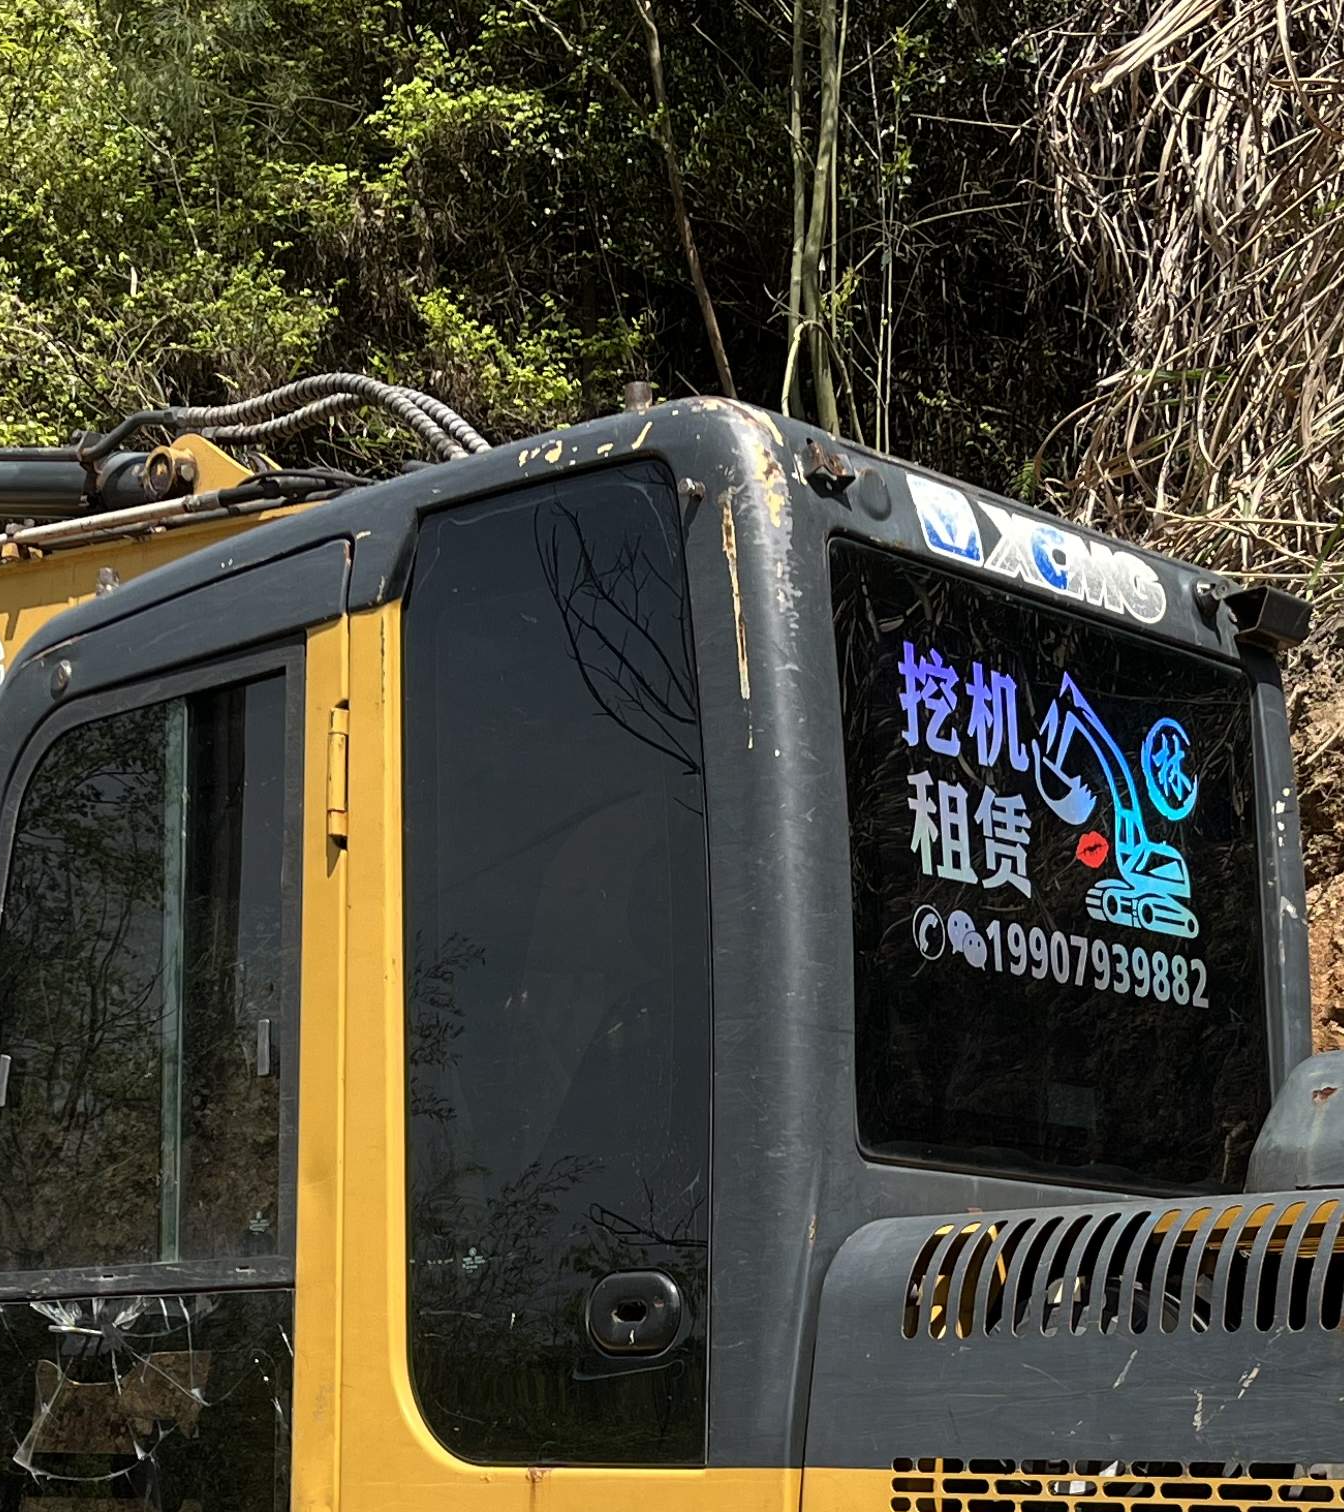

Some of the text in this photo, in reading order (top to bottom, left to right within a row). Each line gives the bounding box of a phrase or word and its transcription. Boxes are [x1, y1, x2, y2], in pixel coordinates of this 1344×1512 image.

[978, 501, 1167, 623] XCMG
[898, 640, 1029, 772] 挖机
[907, 770, 1032, 899] 租赁
[986, 919, 1209, 1009] 19907939882
